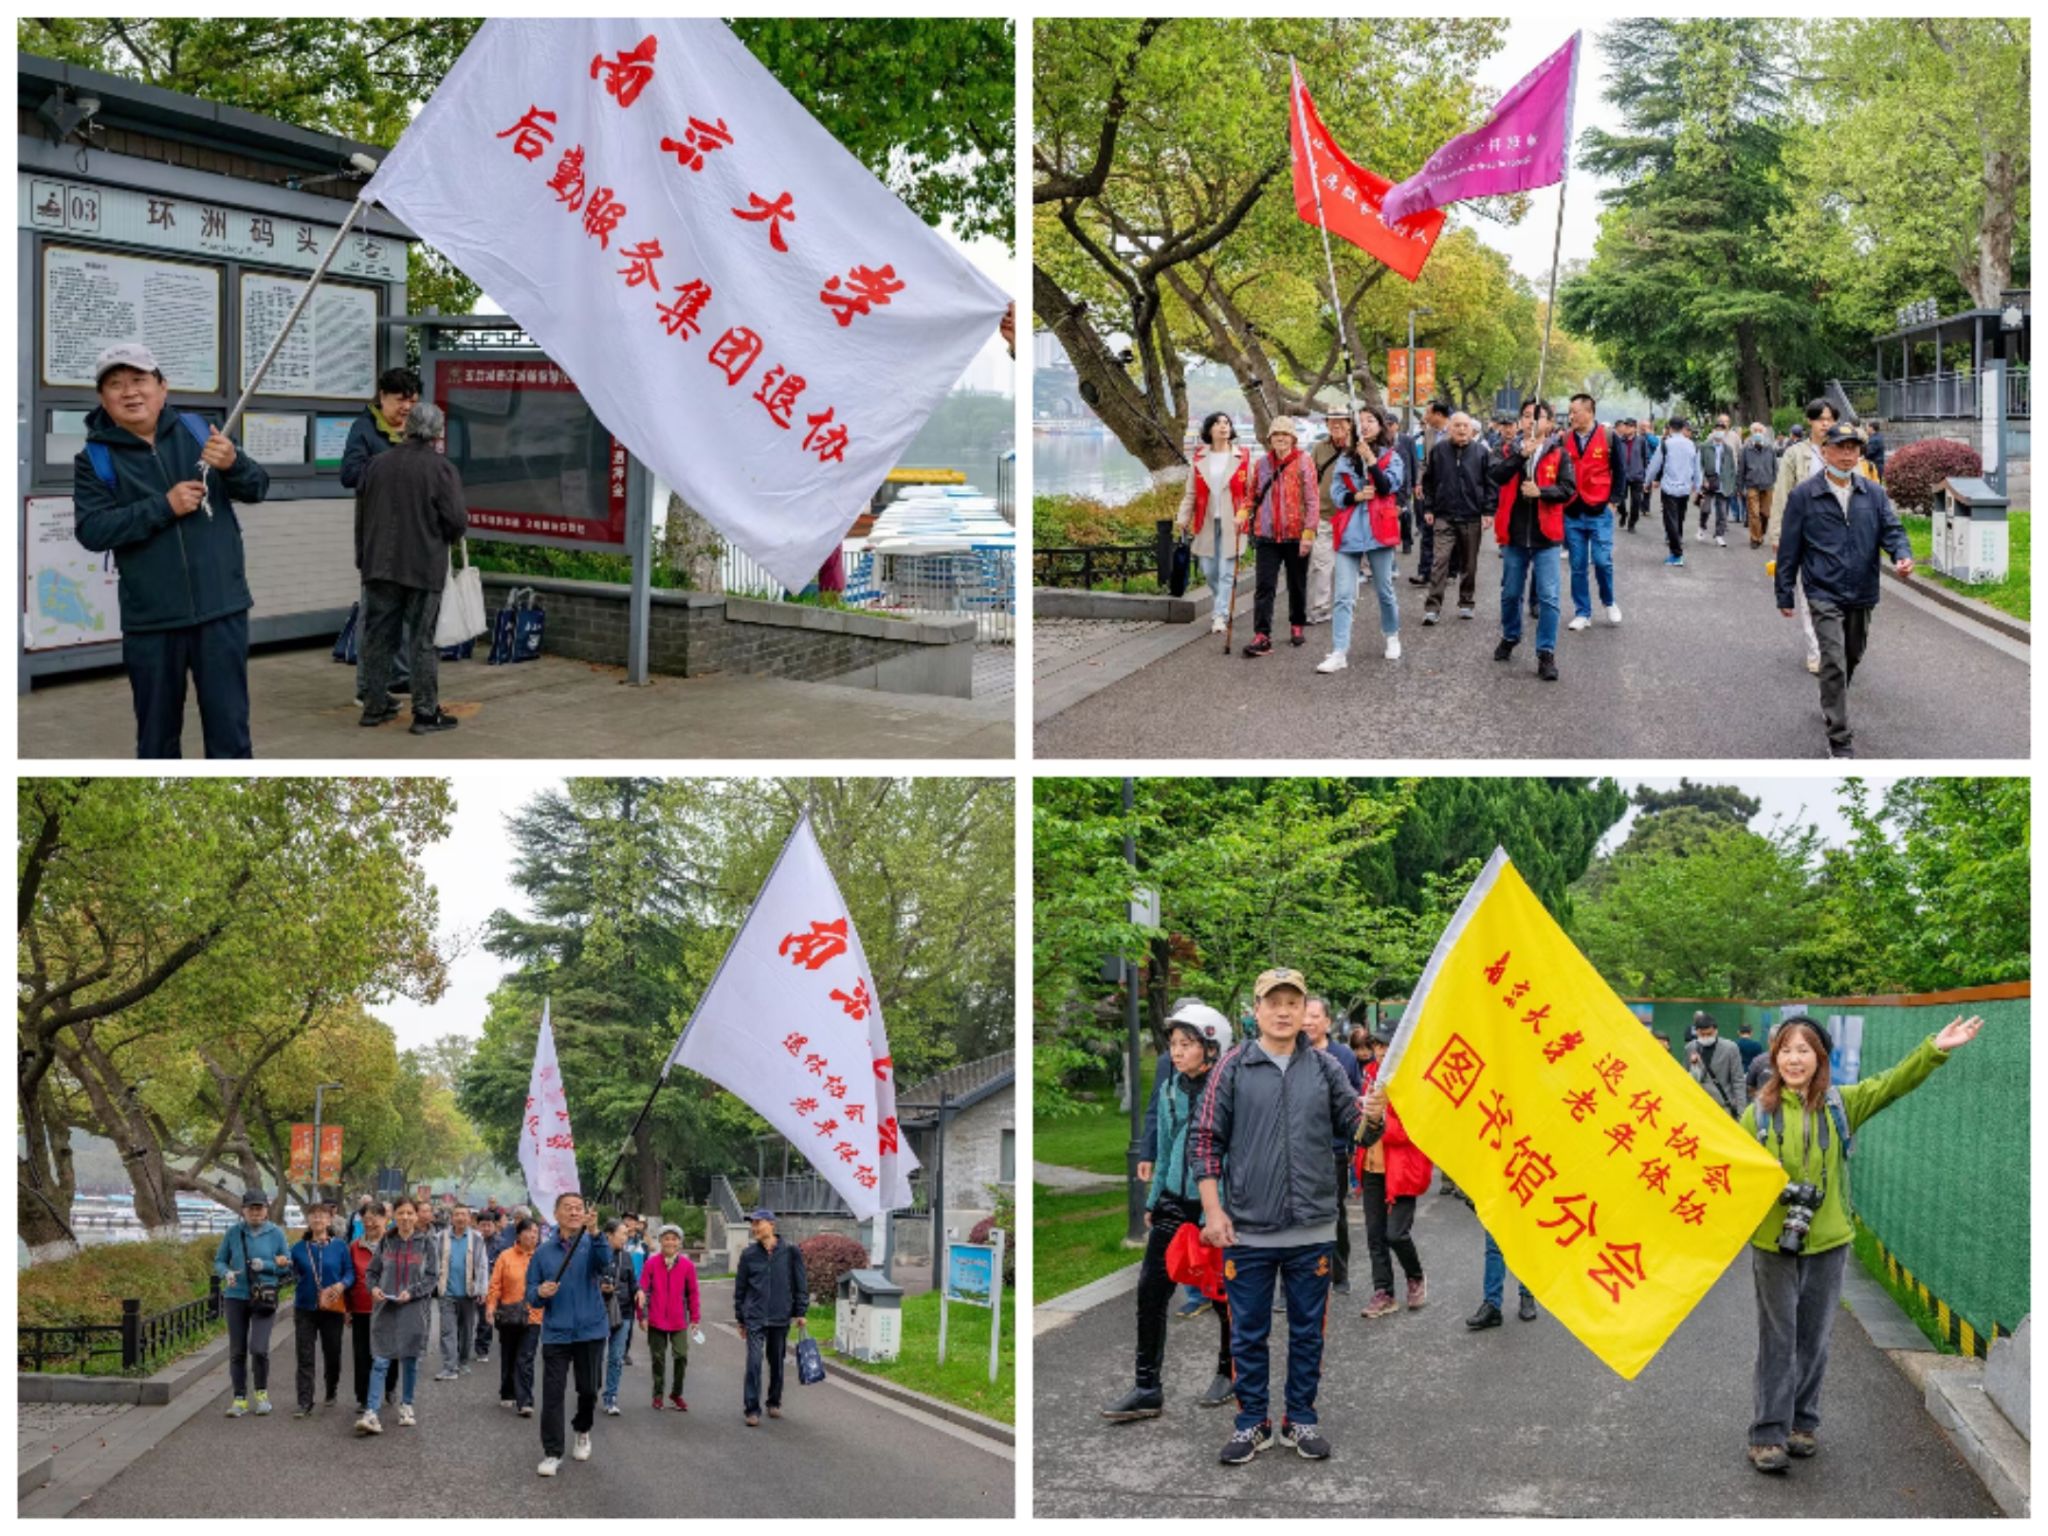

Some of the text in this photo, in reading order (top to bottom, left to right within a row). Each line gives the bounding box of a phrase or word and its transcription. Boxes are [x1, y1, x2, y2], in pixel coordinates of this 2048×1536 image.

[71, 197, 97, 221] 03
[147, 199, 318, 254] 环洲码头
[496, 104, 850, 463] 后勤服务集团退协
[1422, 1032, 1647, 1304] 图书馆分会
[1562, 1090, 1707, 1227] 老年体协
[1591, 1052, 1732, 1195] 退休协会
